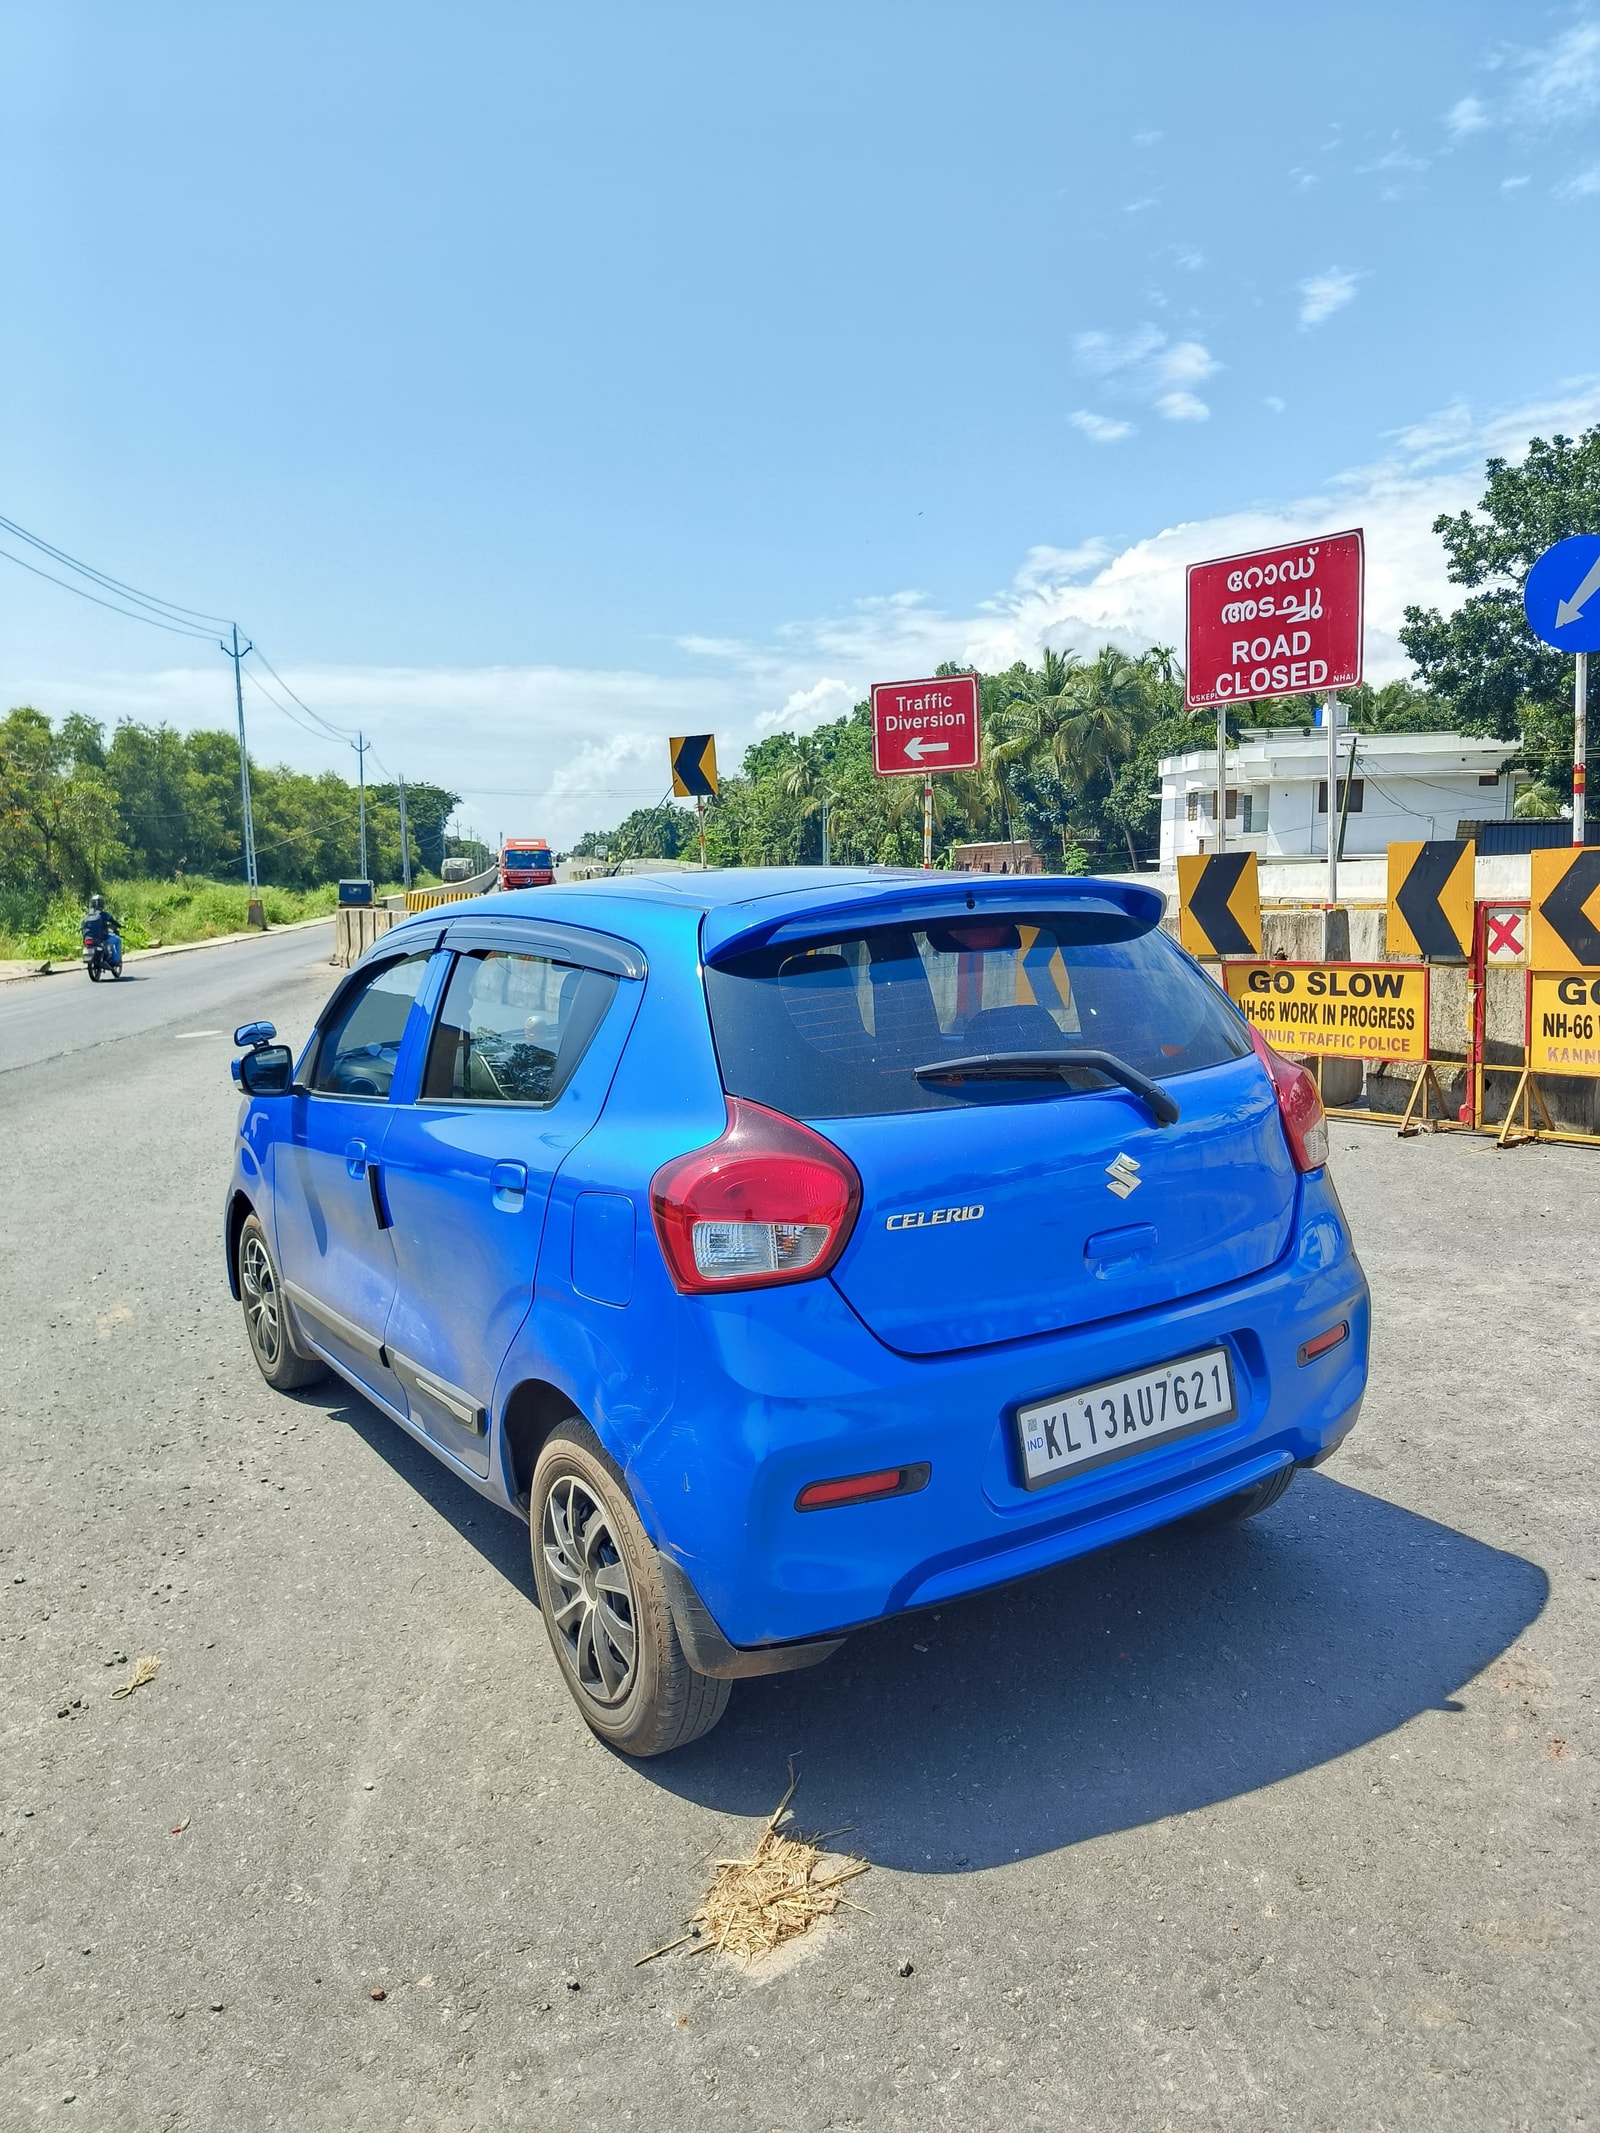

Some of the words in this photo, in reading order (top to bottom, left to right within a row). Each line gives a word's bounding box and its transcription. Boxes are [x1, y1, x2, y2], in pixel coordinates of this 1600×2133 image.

[1227, 546, 1320, 592] റോഡ്
[1221, 587, 1323, 624] അടച്ചു
[1232, 631, 1311, 665] ROAD
[1215, 659, 1328, 697] CLOSED
[1333, 672, 1354, 683] NHAI
[896, 693, 953, 712] Traffic
[885, 711, 966, 732] Diversion
[1248, 970, 1295, 994] GO
[1307, 971, 1405, 999] SLOW
[1238, 999, 1275, 1022] NH-66
[1279, 1001, 1318, 1024] WORK
[1322, 1003, 1336, 1026] IN
[1340, 1004, 1415, 1031] PROGRESS
[1542, 1012, 1593, 1040] NH-66
[1259, 1028, 1295, 1044] NNUR
[1299, 1031, 1355, 1049] TRAFFIC
[1359, 1035, 1411, 1052] POLICE
[1547, 1046, 1600, 1065] KANN
[886, 1204, 985, 1231] CELERIO
[1043, 1364, 1222, 1460] KL13AU7621
[1026, 1436, 1044, 1452] IND
